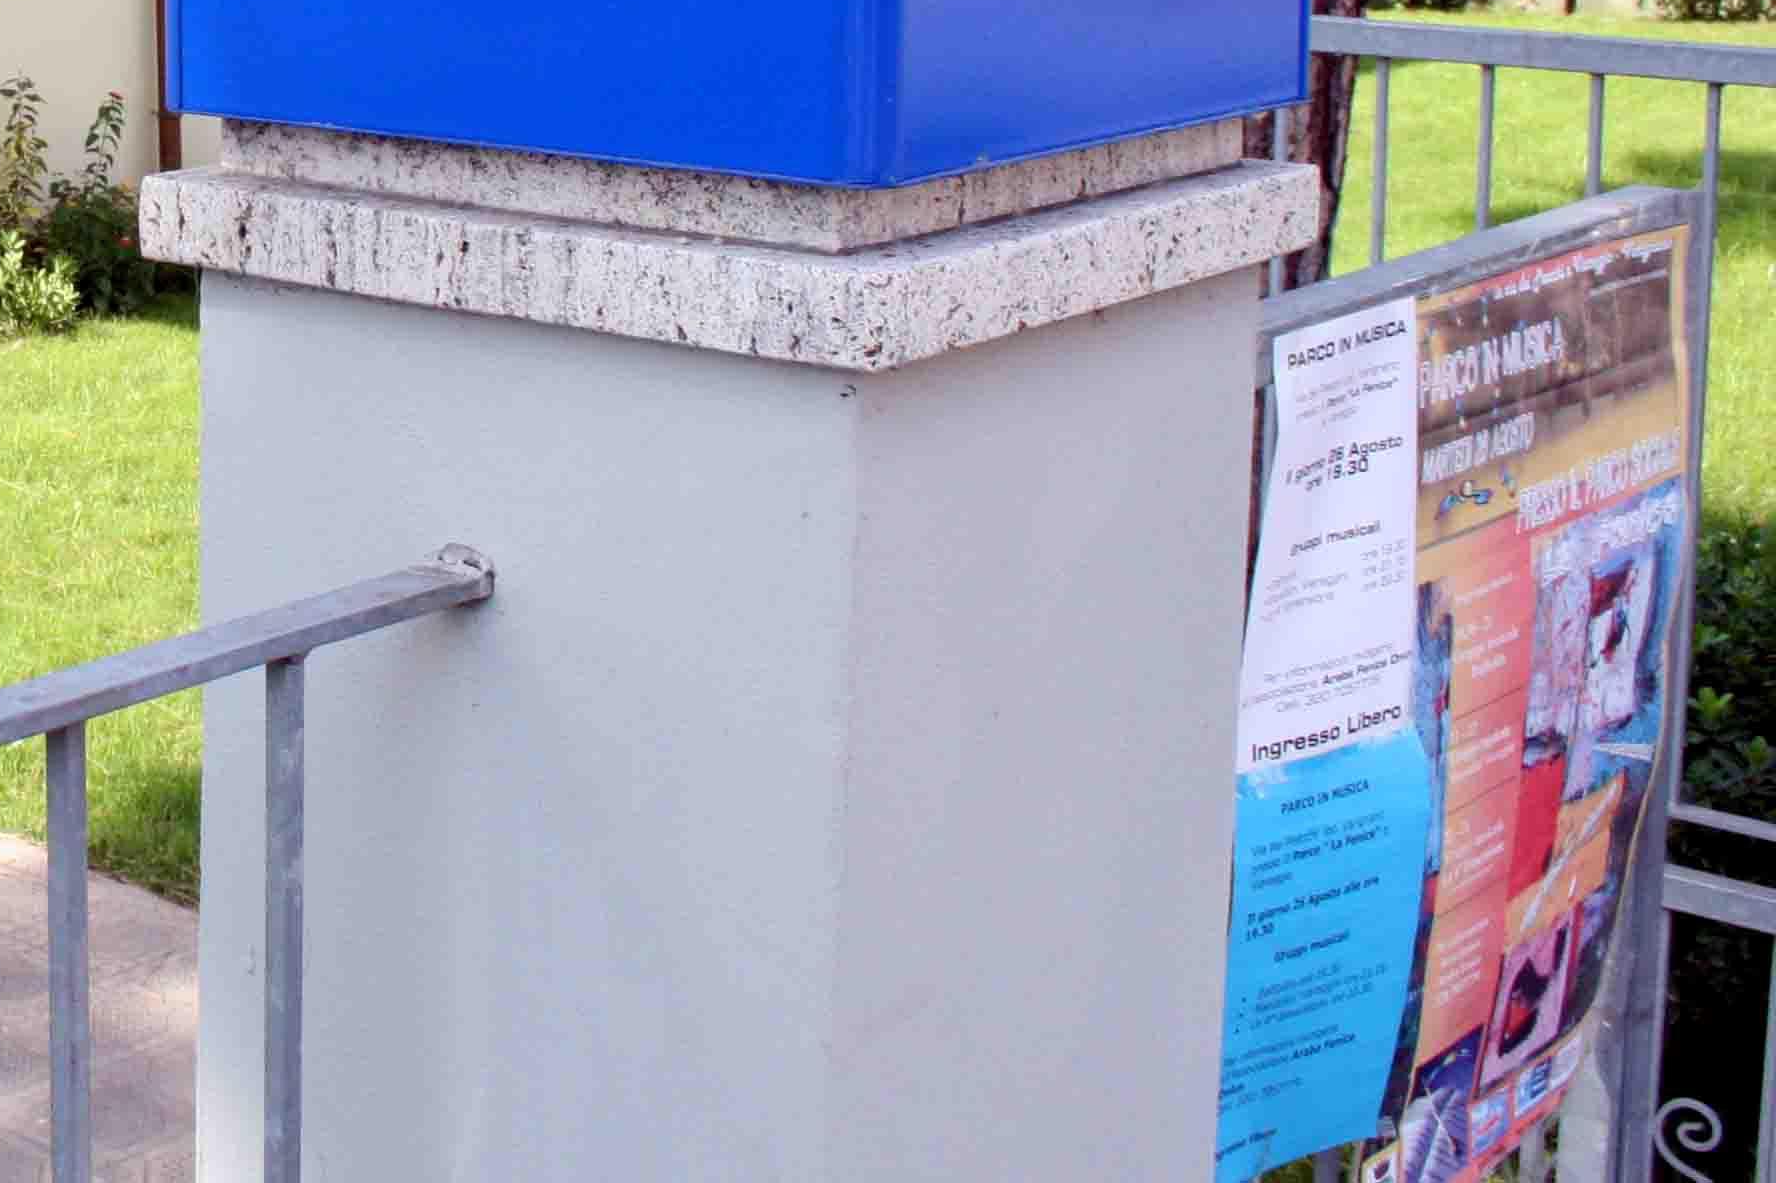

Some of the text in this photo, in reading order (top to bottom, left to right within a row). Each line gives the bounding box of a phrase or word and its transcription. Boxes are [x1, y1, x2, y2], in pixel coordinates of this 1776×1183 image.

[1287, 320, 1409, 370] PARCO IN MUSICA
[1347, 435, 1404, 459] Agosto
[1326, 520, 1381, 544] musicali
[1251, 704, 1402, 763] Ingresso Libero
[1280, 779, 1370, 815] PARCO IN MUSICA
